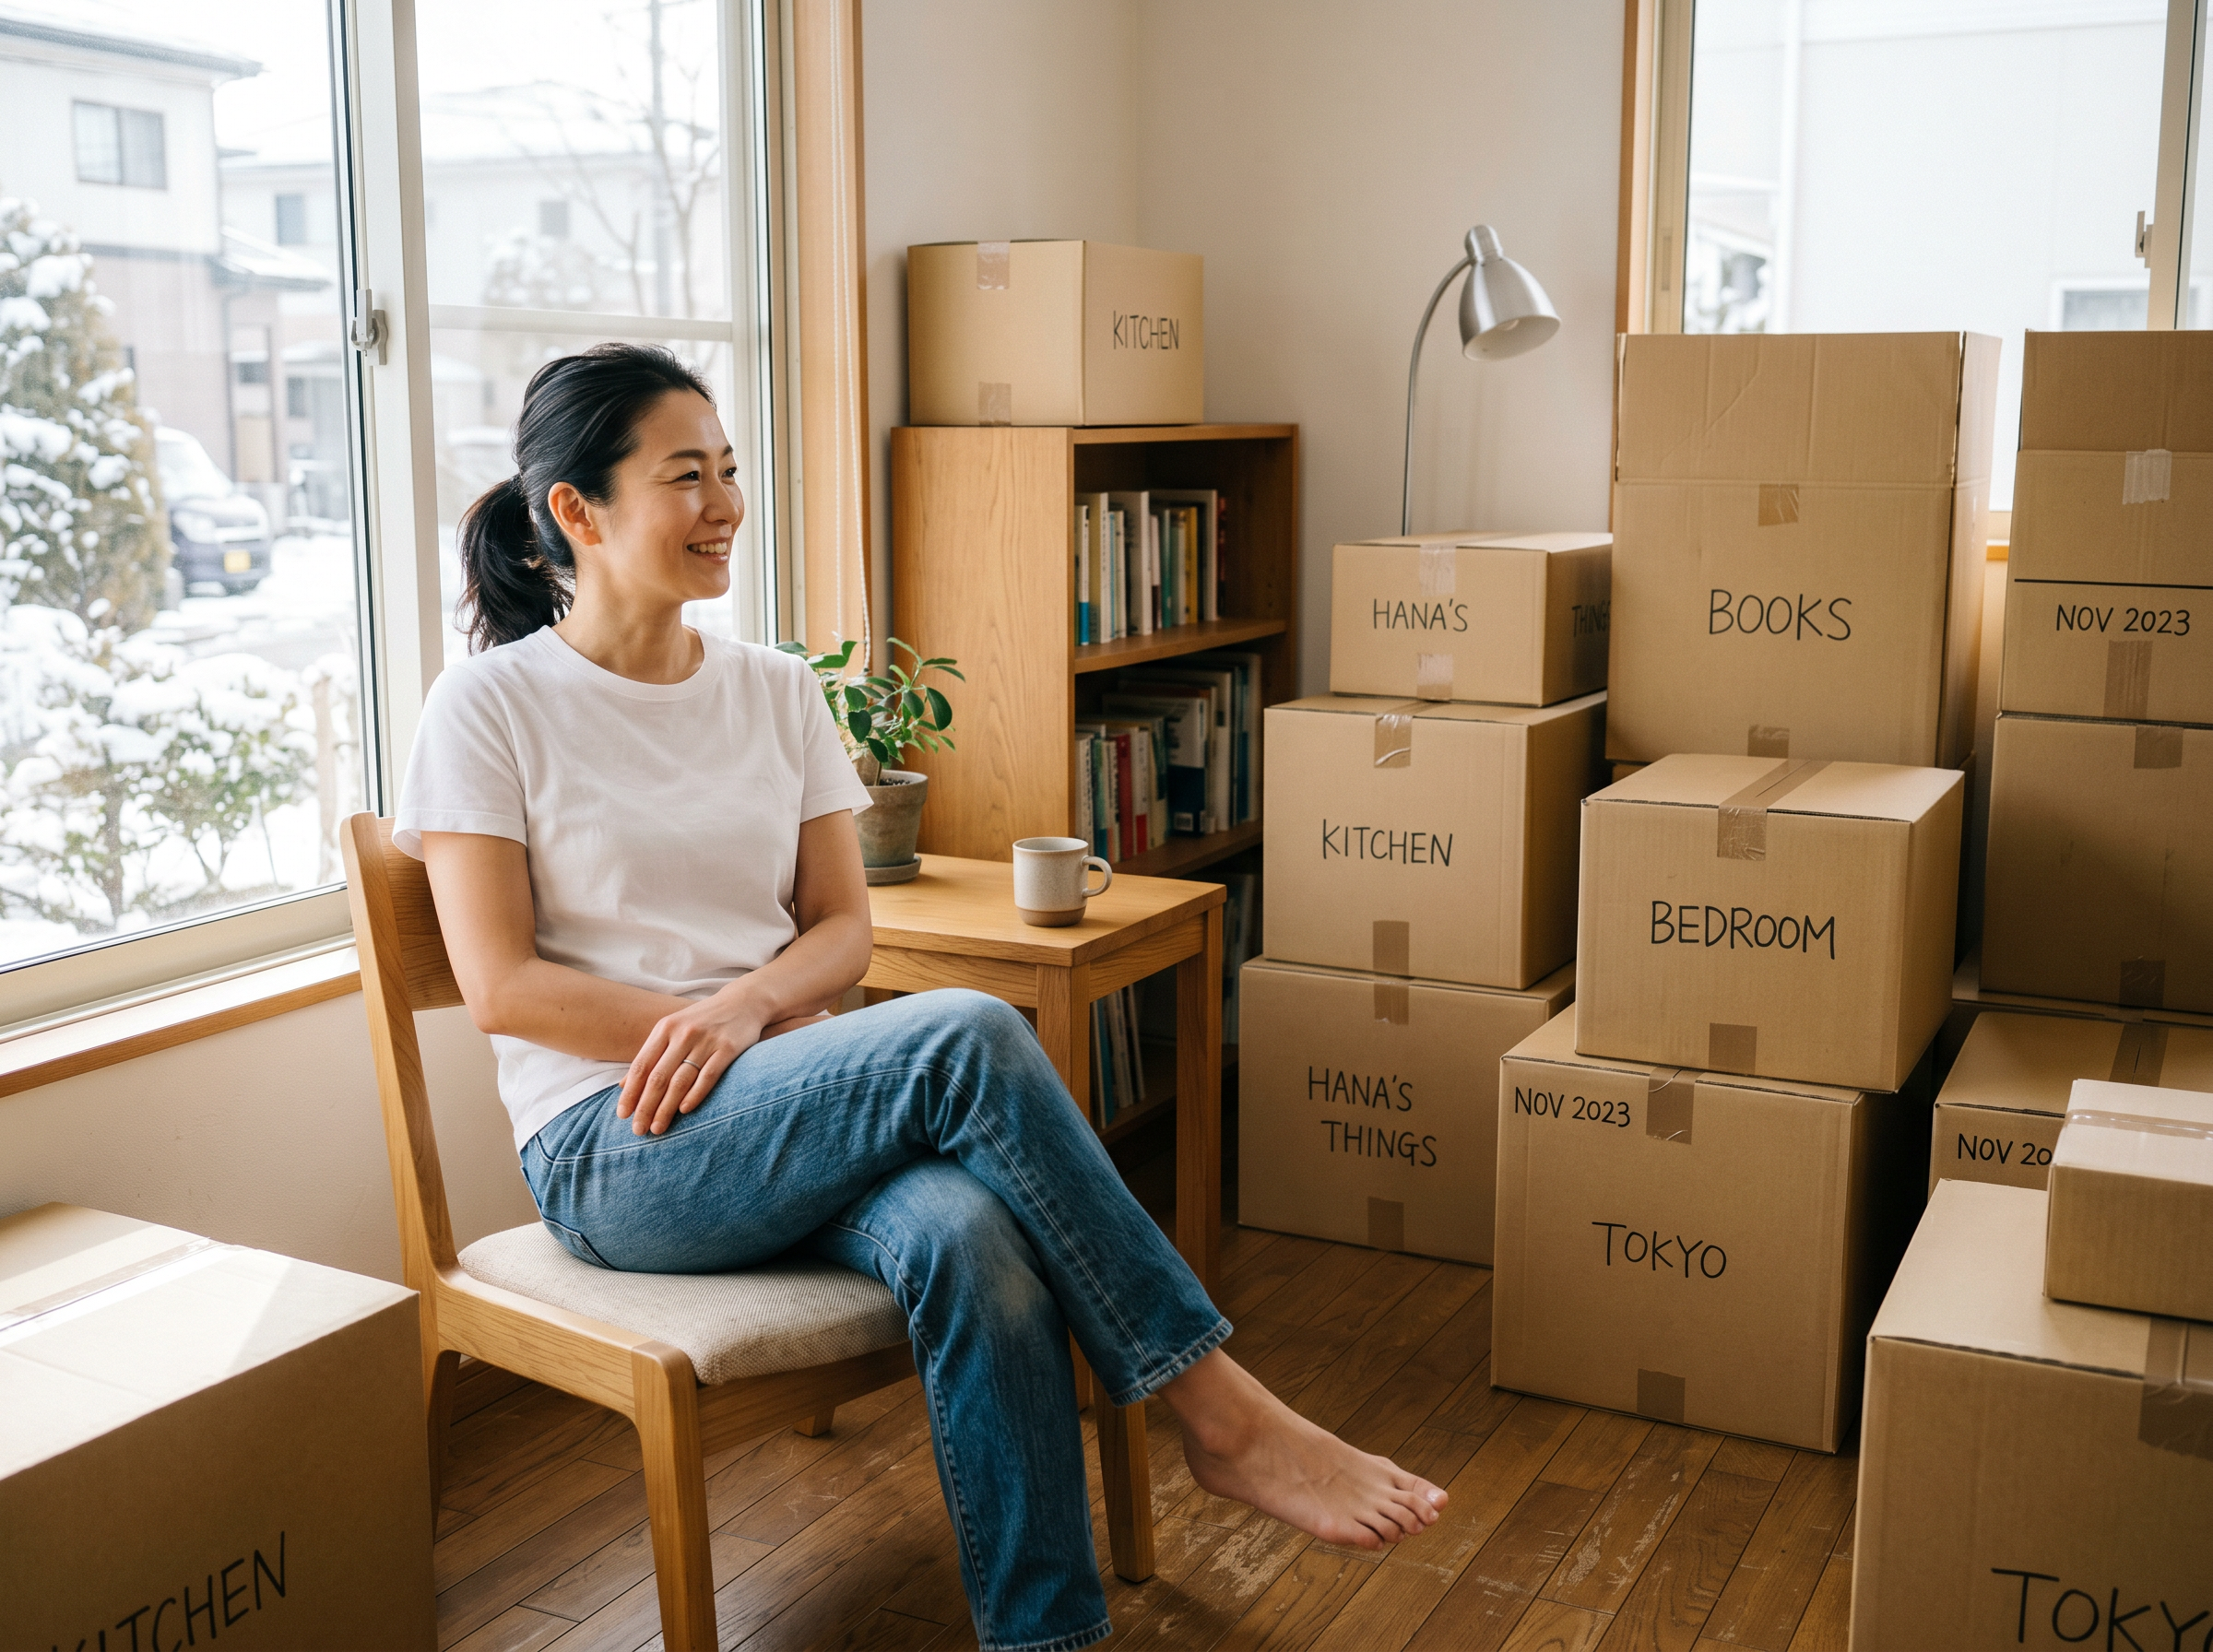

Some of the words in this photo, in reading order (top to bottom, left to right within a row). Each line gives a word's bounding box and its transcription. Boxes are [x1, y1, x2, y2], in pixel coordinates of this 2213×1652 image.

[1113, 311, 1179, 350] KITCHEN
[1373, 598, 1468, 632] HANA'S
[1709, 589, 1852, 641] BOOKS
[2056, 604, 2114, 632] NOV
[2123, 608, 2191, 636] 2023
[1322, 819, 1453, 867] KITCHEN
[1651, 900, 1836, 961] BEDROOM
[1308, 1066, 1413, 1112] HANA'S
[1514, 1086, 1565, 1119] NOV
[1571, 1095, 1631, 1128] 2023
[1320, 1120, 1437, 1167] THINGS
[1958, 1133, 2014, 1164] NOV
[2019, 1142, 2053, 1166] 20
[1592, 1221, 1727, 1279] TOKYO
[52, 1530, 287, 1652] TCHEN
[1990, 1567, 2213, 1652] TOKY
